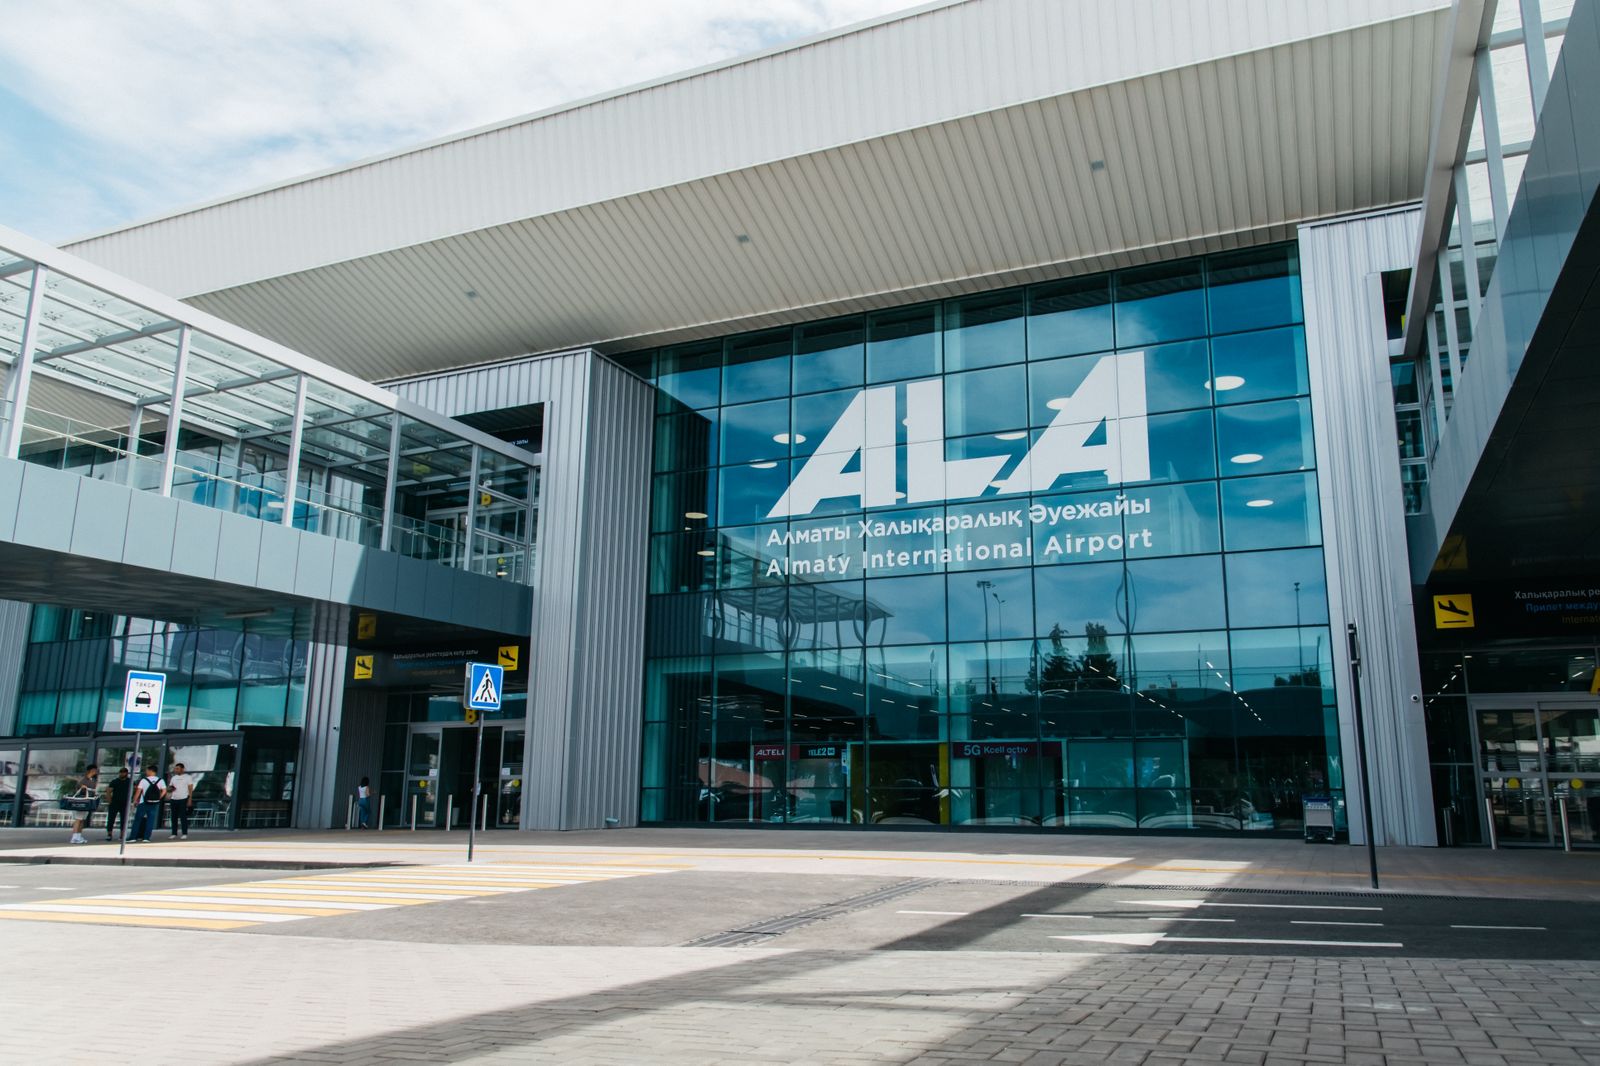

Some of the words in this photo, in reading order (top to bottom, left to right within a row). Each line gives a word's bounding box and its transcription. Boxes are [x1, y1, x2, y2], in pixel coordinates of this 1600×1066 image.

[766, 351, 1151, 518] ALA
[766, 526, 850, 546] Алматы
[858, 510, 1023, 538] Халықаралық
[1029, 494, 1151, 525] Әуежайы
[766, 553, 850, 577] Almaty
[863, 537, 1031, 569] International
[1043, 529, 1152, 556] Airport
[963, 744, 981, 756] 5G
[983, 746, 1005, 754] Kcell
